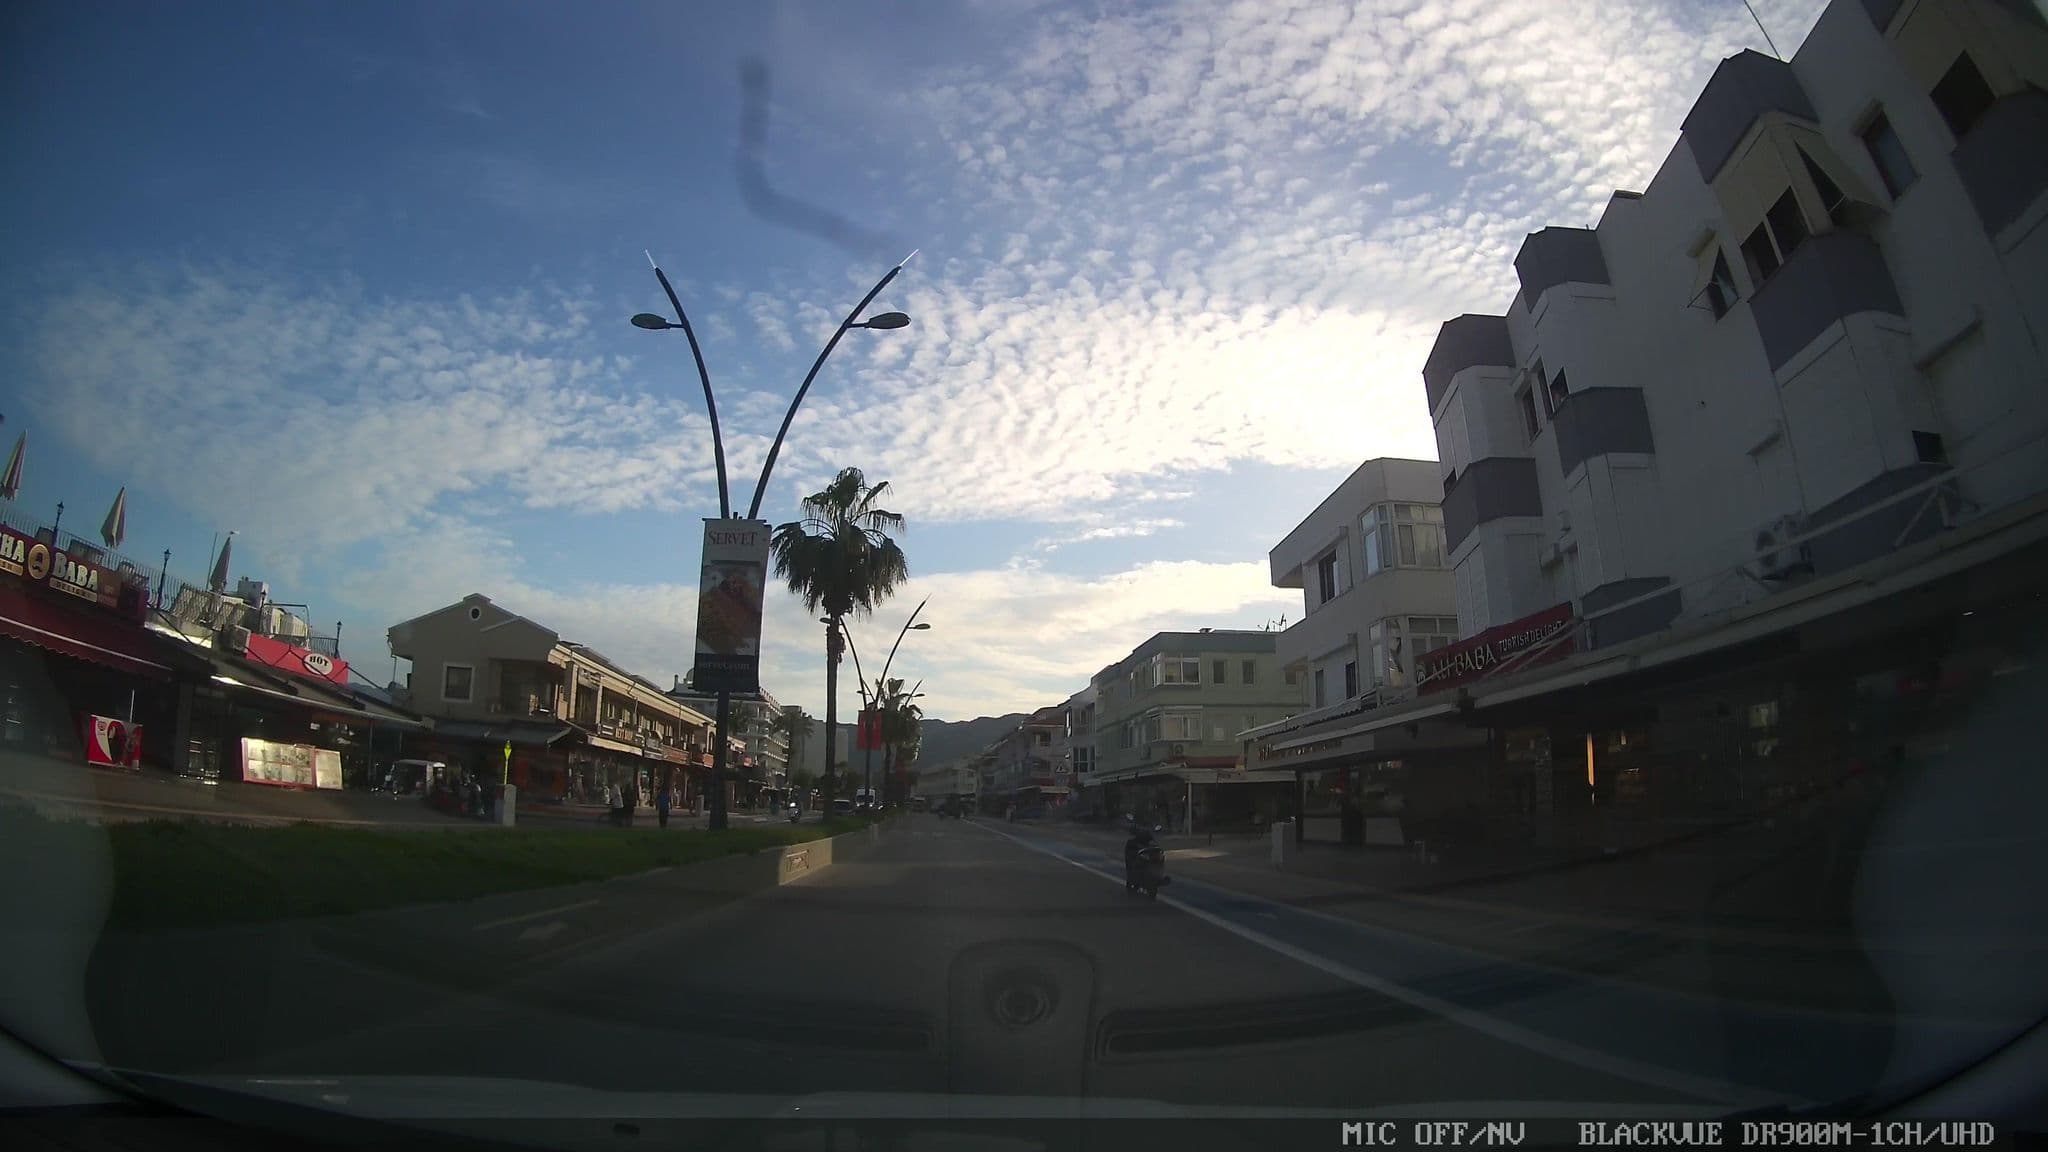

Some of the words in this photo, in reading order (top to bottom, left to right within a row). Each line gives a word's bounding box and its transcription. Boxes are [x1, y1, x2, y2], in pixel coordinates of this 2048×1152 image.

[708, 531, 757, 545] SERVET
[0, 532, 25, 564] HA
[53, 552, 98, 590] BABA
[1499, 631, 1529, 652] TURKISH
[1530, 620, 1563, 642] DELIGHT
[309, 656, 329, 666] HOT
[1453, 643, 1496, 676] BABA
